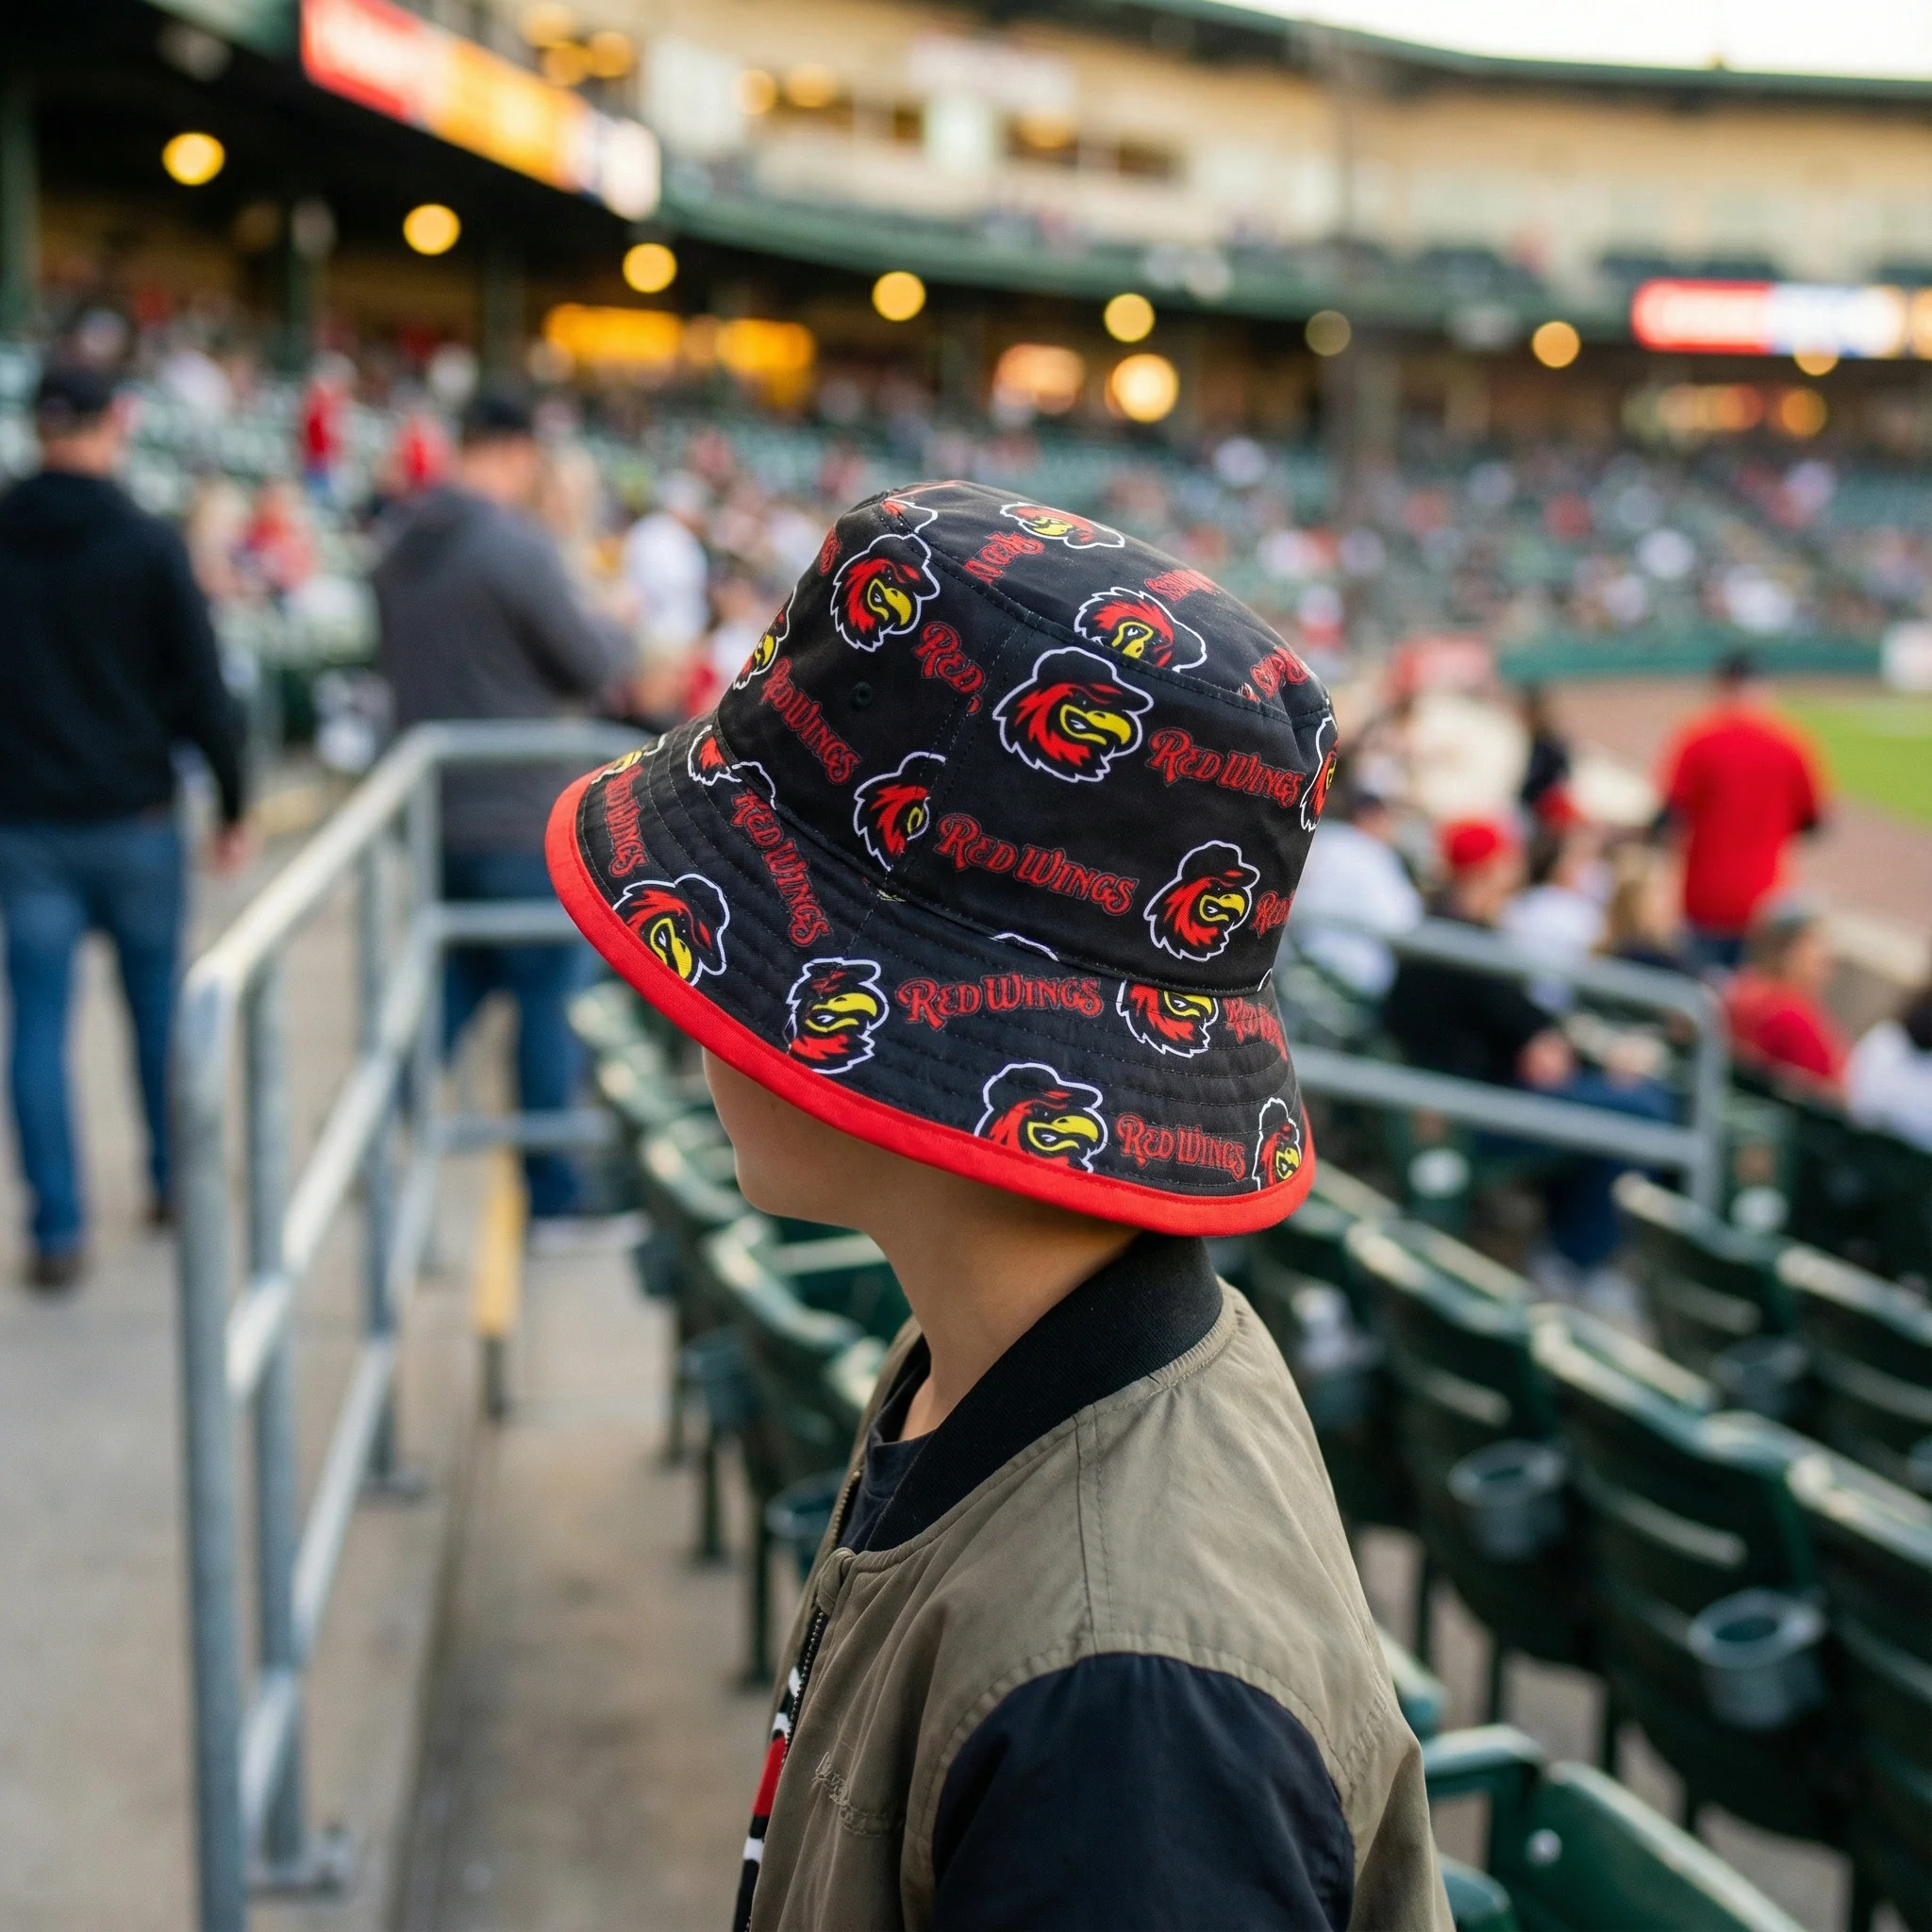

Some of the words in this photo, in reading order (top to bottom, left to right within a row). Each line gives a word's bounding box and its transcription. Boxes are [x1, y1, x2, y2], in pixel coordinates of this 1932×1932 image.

[782, 689, 860, 785] WINGS
[1148, 727, 1222, 786] RED
[1218, 750, 1305, 808] WINGS
[763, 839, 831, 948] WINGS
[935, 814, 1018, 871] RED
[1015, 843, 1139, 915] WINGS
[895, 976, 983, 1030] RED
[983, 972, 1105, 1016] WINGS
[1115, 1112, 1176, 1169] RED
[1175, 1124, 1246, 1181] WINGS
